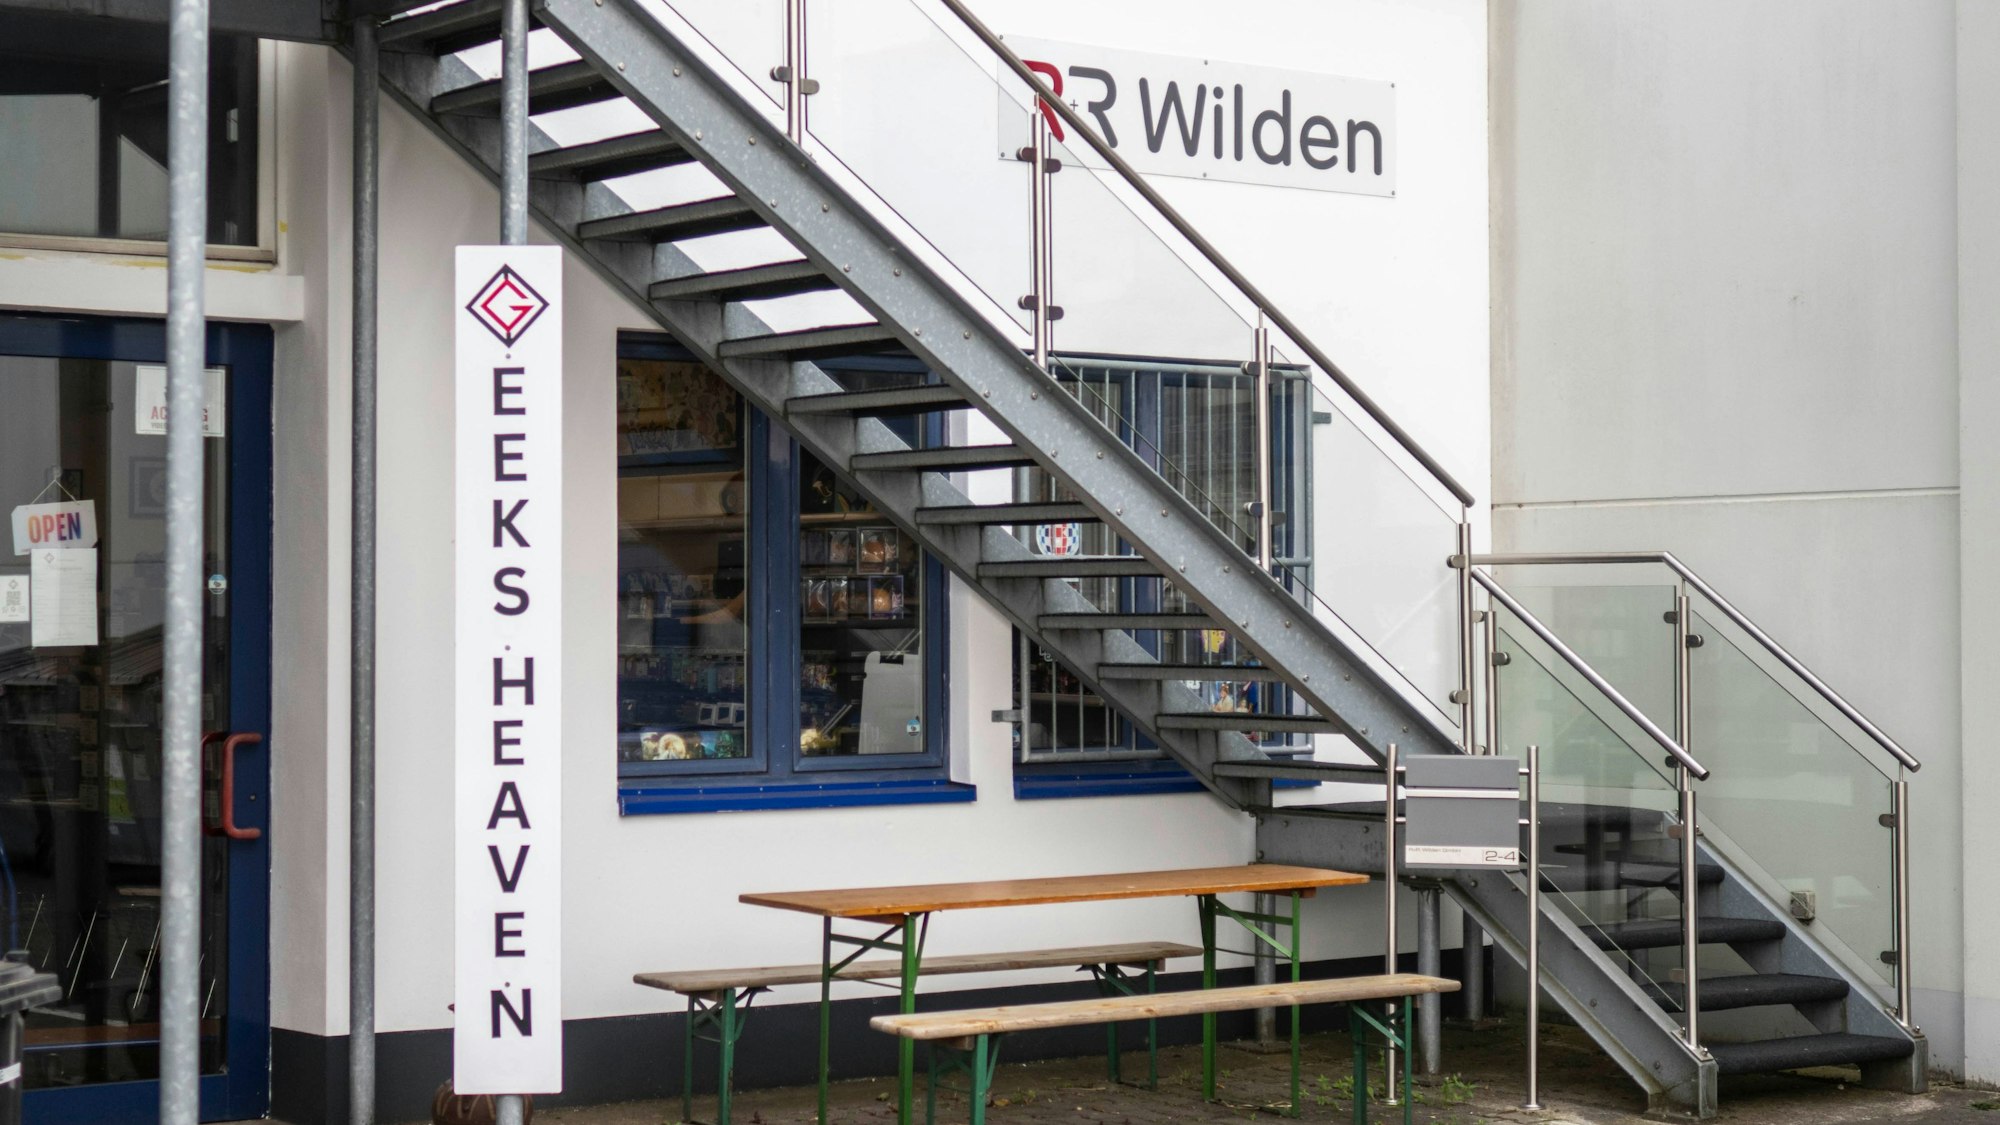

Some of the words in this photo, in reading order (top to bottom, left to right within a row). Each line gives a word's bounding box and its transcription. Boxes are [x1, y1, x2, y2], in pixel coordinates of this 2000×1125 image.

[1138, 76, 1383, 176] Wilden
[27, 511, 82, 544] OPEN
[485, 655, 536, 1040] HEAVEN
[1485, 850, 1517, 862] 2-4
